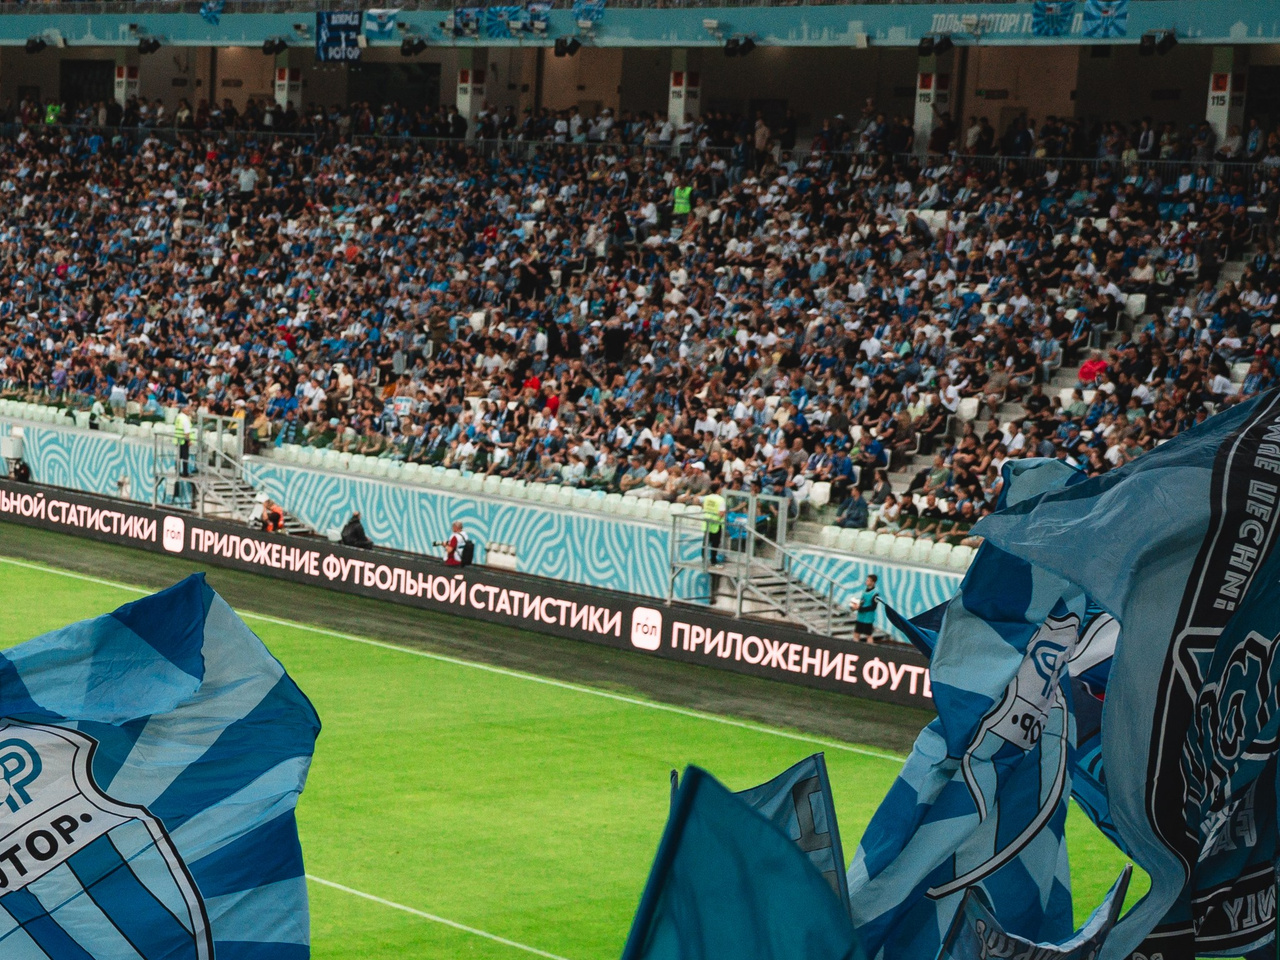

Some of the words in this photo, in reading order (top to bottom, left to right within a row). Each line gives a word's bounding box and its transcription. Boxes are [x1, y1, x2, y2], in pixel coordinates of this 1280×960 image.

[47, 499, 157, 542] СТАТИСТИКИ
[190, 527, 320, 576] ПРИЛОЖЕНИЕ
[322, 553, 467, 606] ФУТБОЛЬНОЙ
[469, 582, 622, 637] СТАТИСТИКИ
[671, 621, 859, 683] ПРИЛОЖЕНИЕ
